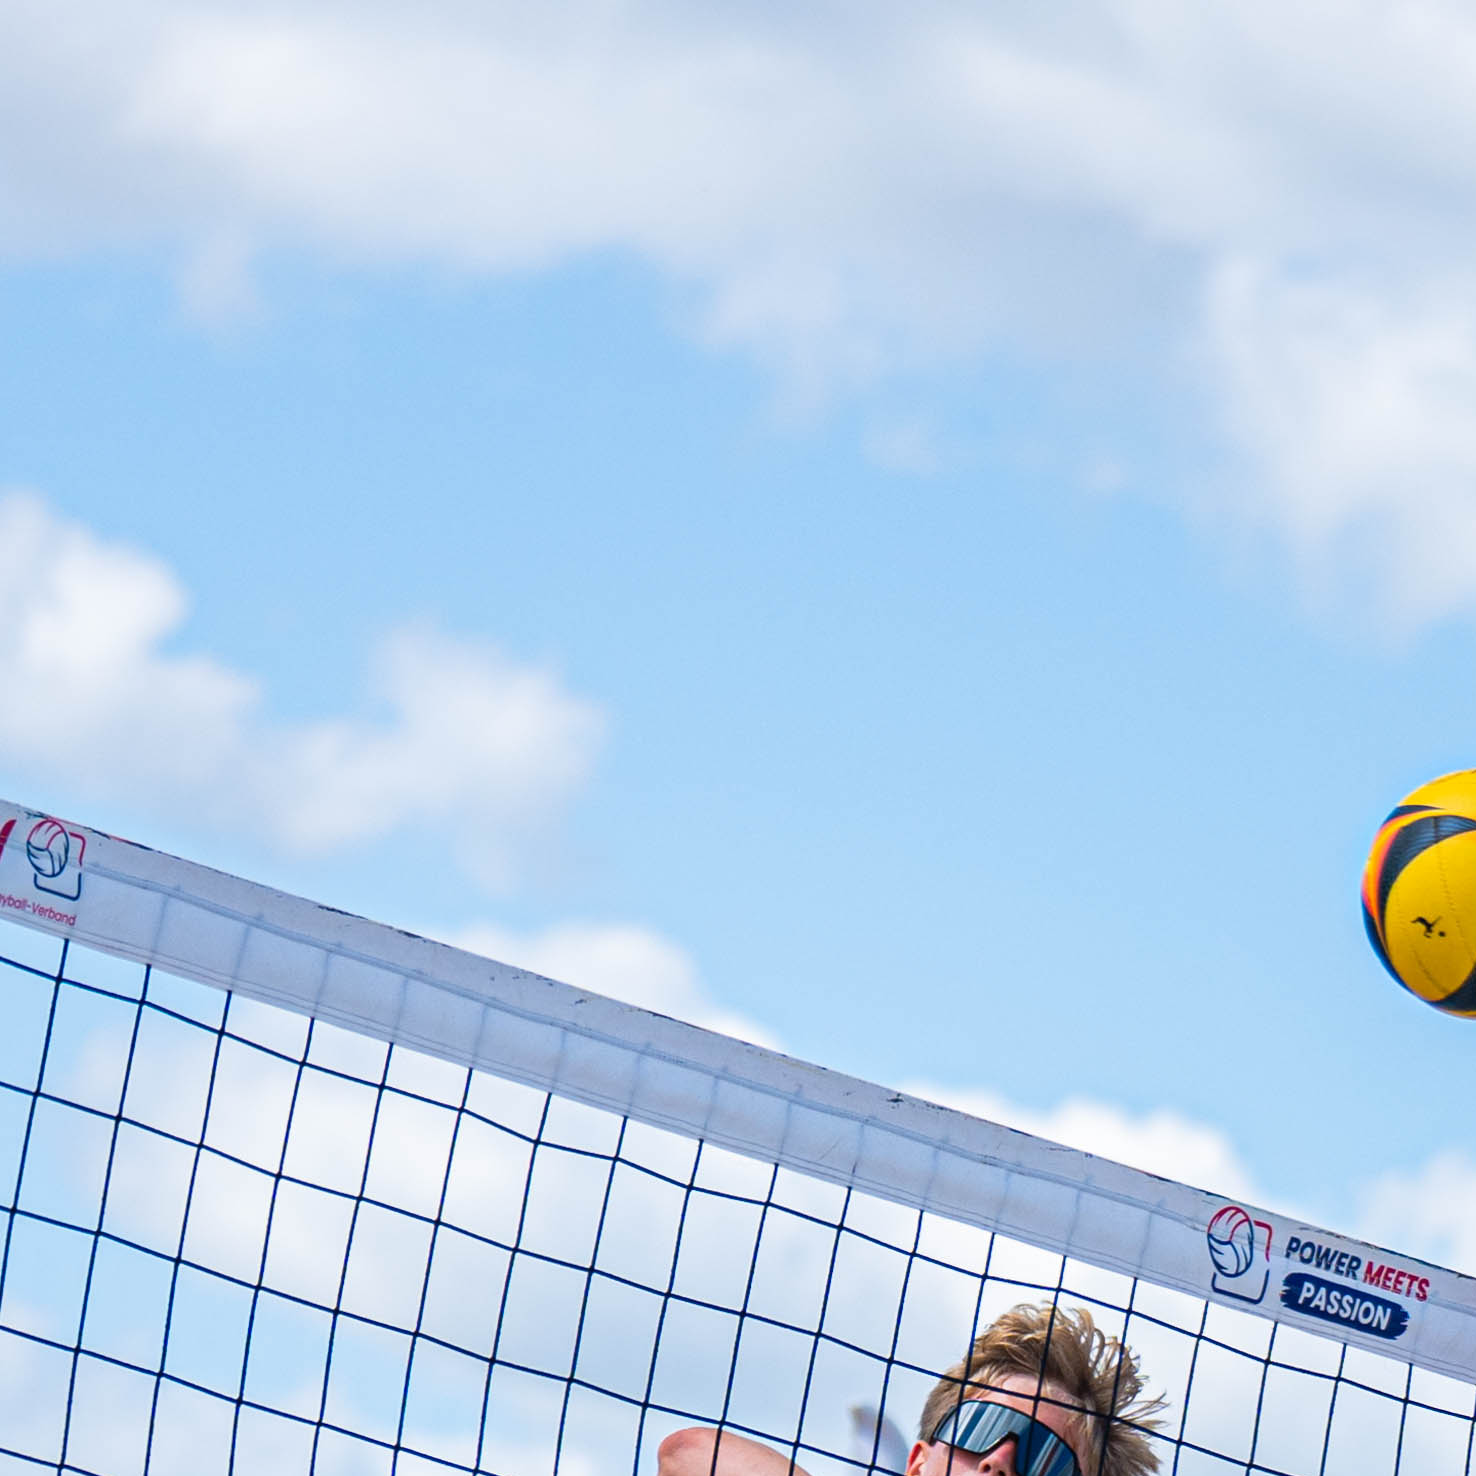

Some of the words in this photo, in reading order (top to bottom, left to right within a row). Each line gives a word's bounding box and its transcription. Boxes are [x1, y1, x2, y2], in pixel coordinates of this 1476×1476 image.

[1285, 1236, 1362, 1280] POWER
[1362, 1261, 1431, 1302] MEETS
[1298, 1281, 1392, 1331] PASSION
